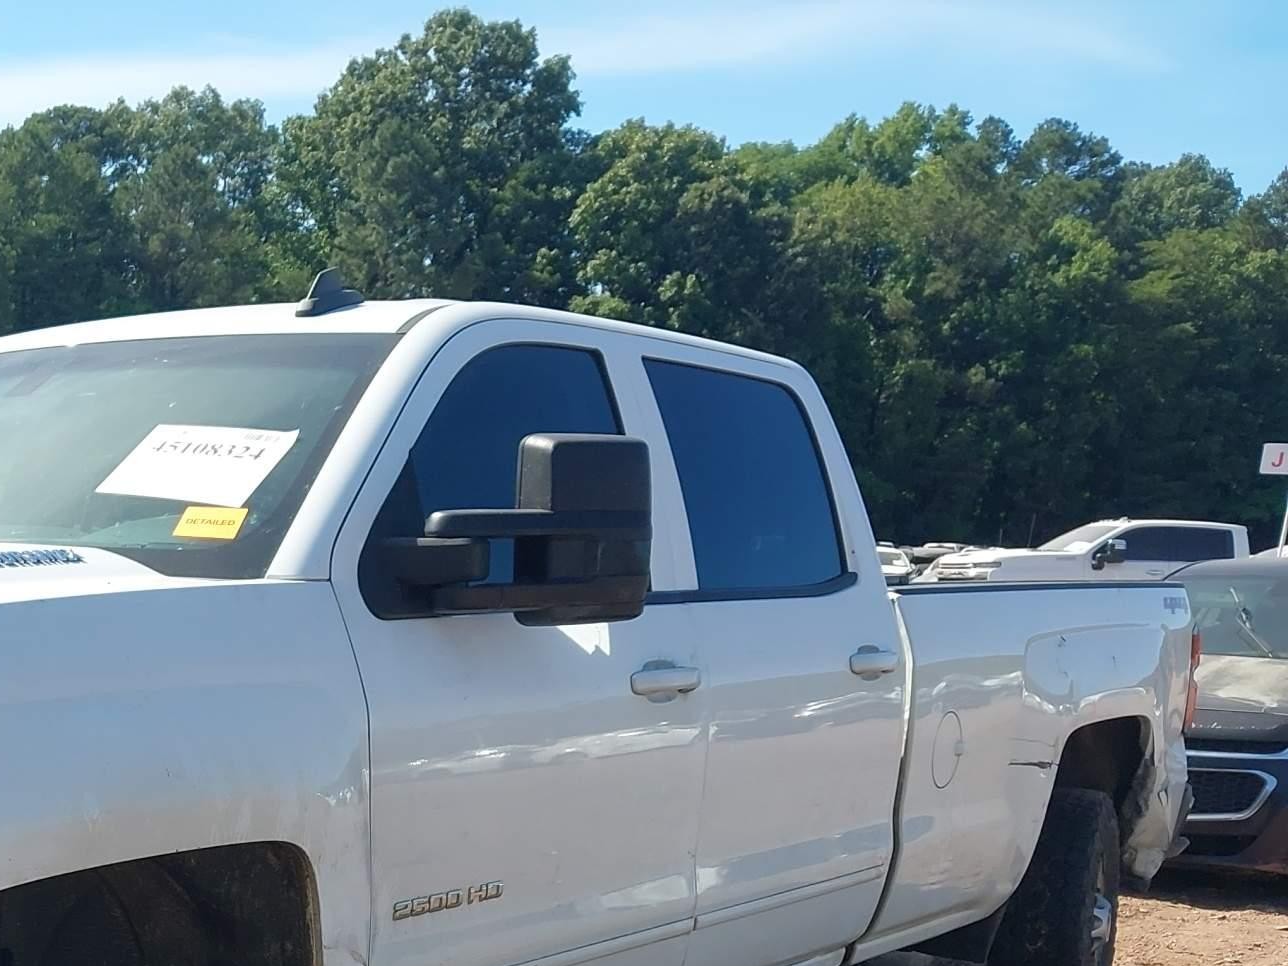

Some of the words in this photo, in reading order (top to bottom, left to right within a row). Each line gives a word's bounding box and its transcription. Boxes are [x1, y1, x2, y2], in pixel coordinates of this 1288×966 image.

[1272, 451, 1284, 467] J
[185, 518, 236, 526] DETAILED
[392, 888, 464, 921] 2500
[467, 880, 504, 905] HD
